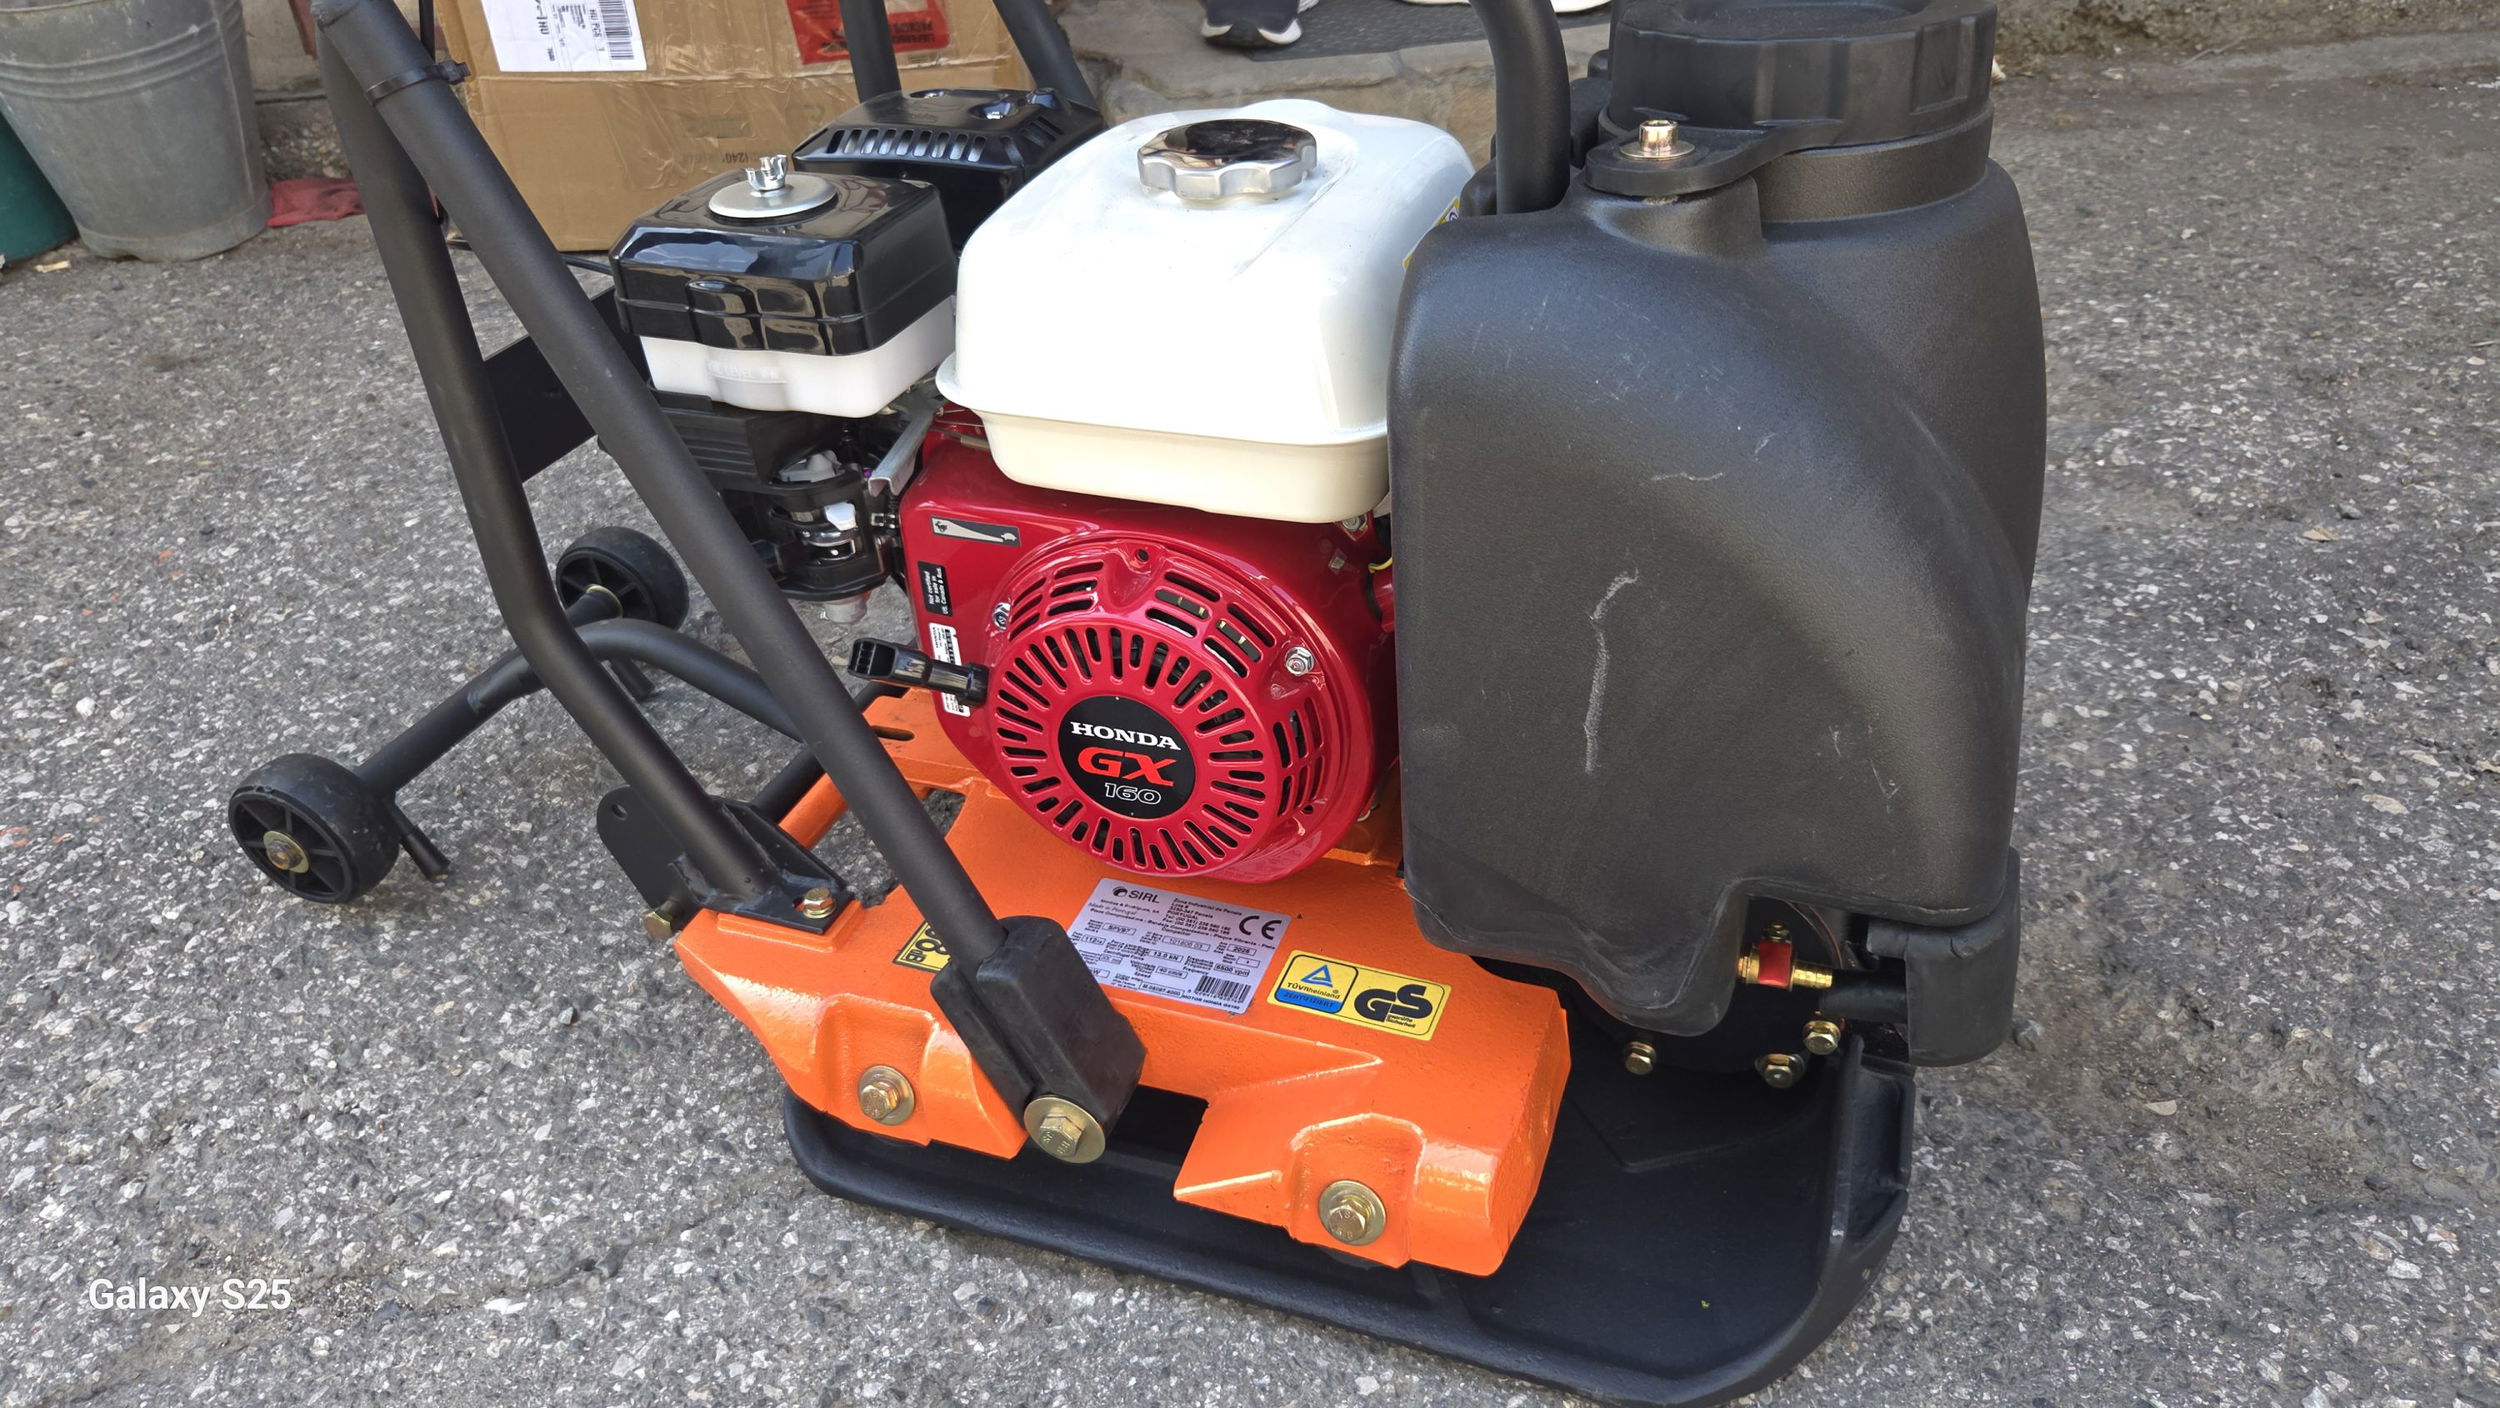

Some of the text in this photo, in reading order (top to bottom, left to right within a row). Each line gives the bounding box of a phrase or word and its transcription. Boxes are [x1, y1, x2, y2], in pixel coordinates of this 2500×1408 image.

[924, 571, 932, 594] certified
[1070, 721, 1181, 751] HONDA
[1078, 746, 1176, 787] GX
[1105, 782, 1162, 805] 160
[1128, 890, 1159, 904] SIRL
[1239, 915, 1282, 940] CE
[1354, 983, 1433, 1022] GS
